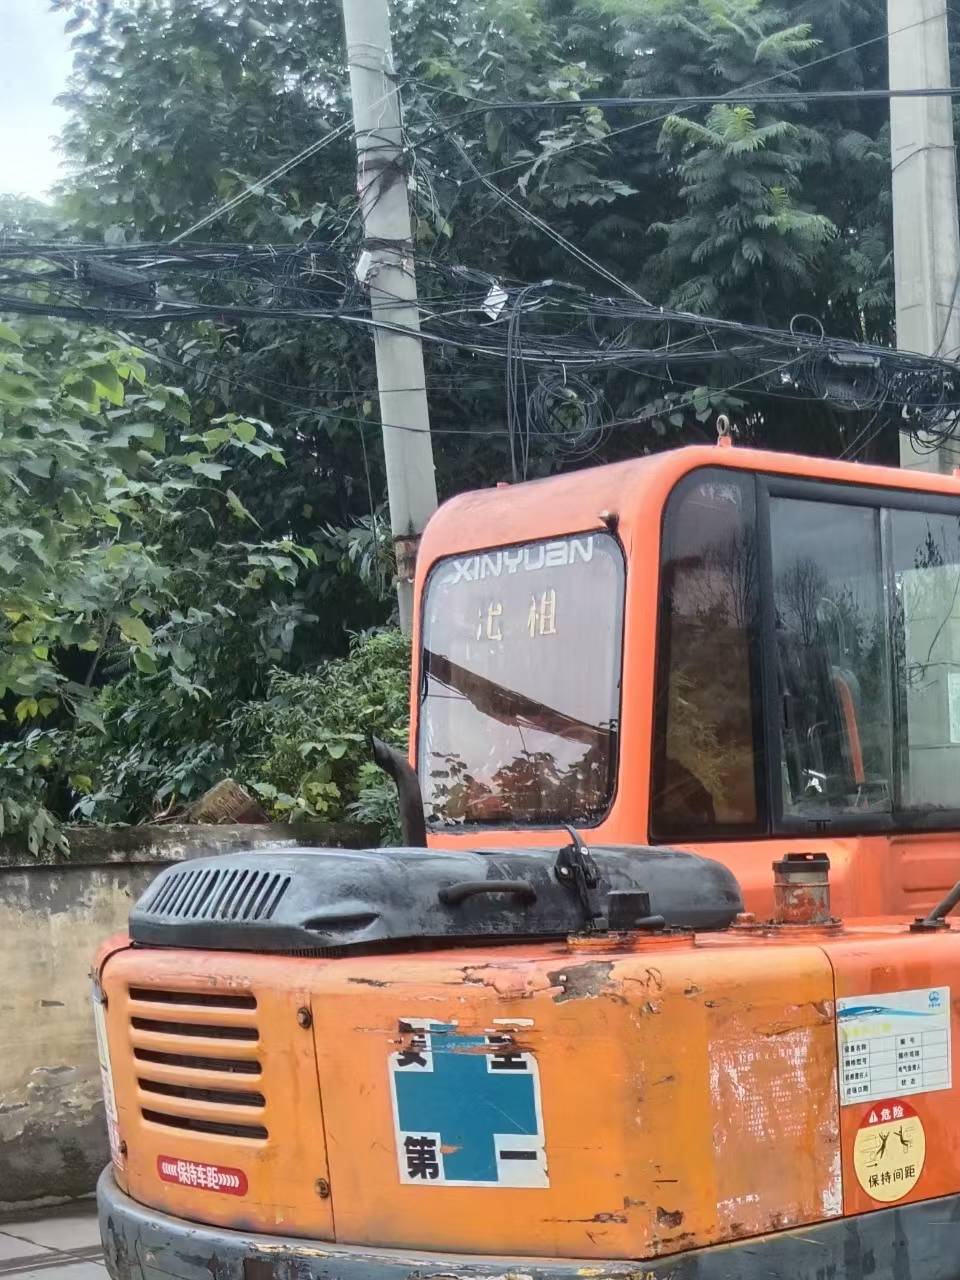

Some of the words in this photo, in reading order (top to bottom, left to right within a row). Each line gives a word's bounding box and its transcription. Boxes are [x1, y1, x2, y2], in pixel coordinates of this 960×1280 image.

[880, 1105, 905, 1121] 危险
[177, 1160, 220, 1190] 保持车距
[868, 1164, 916, 1189] 保持间距
